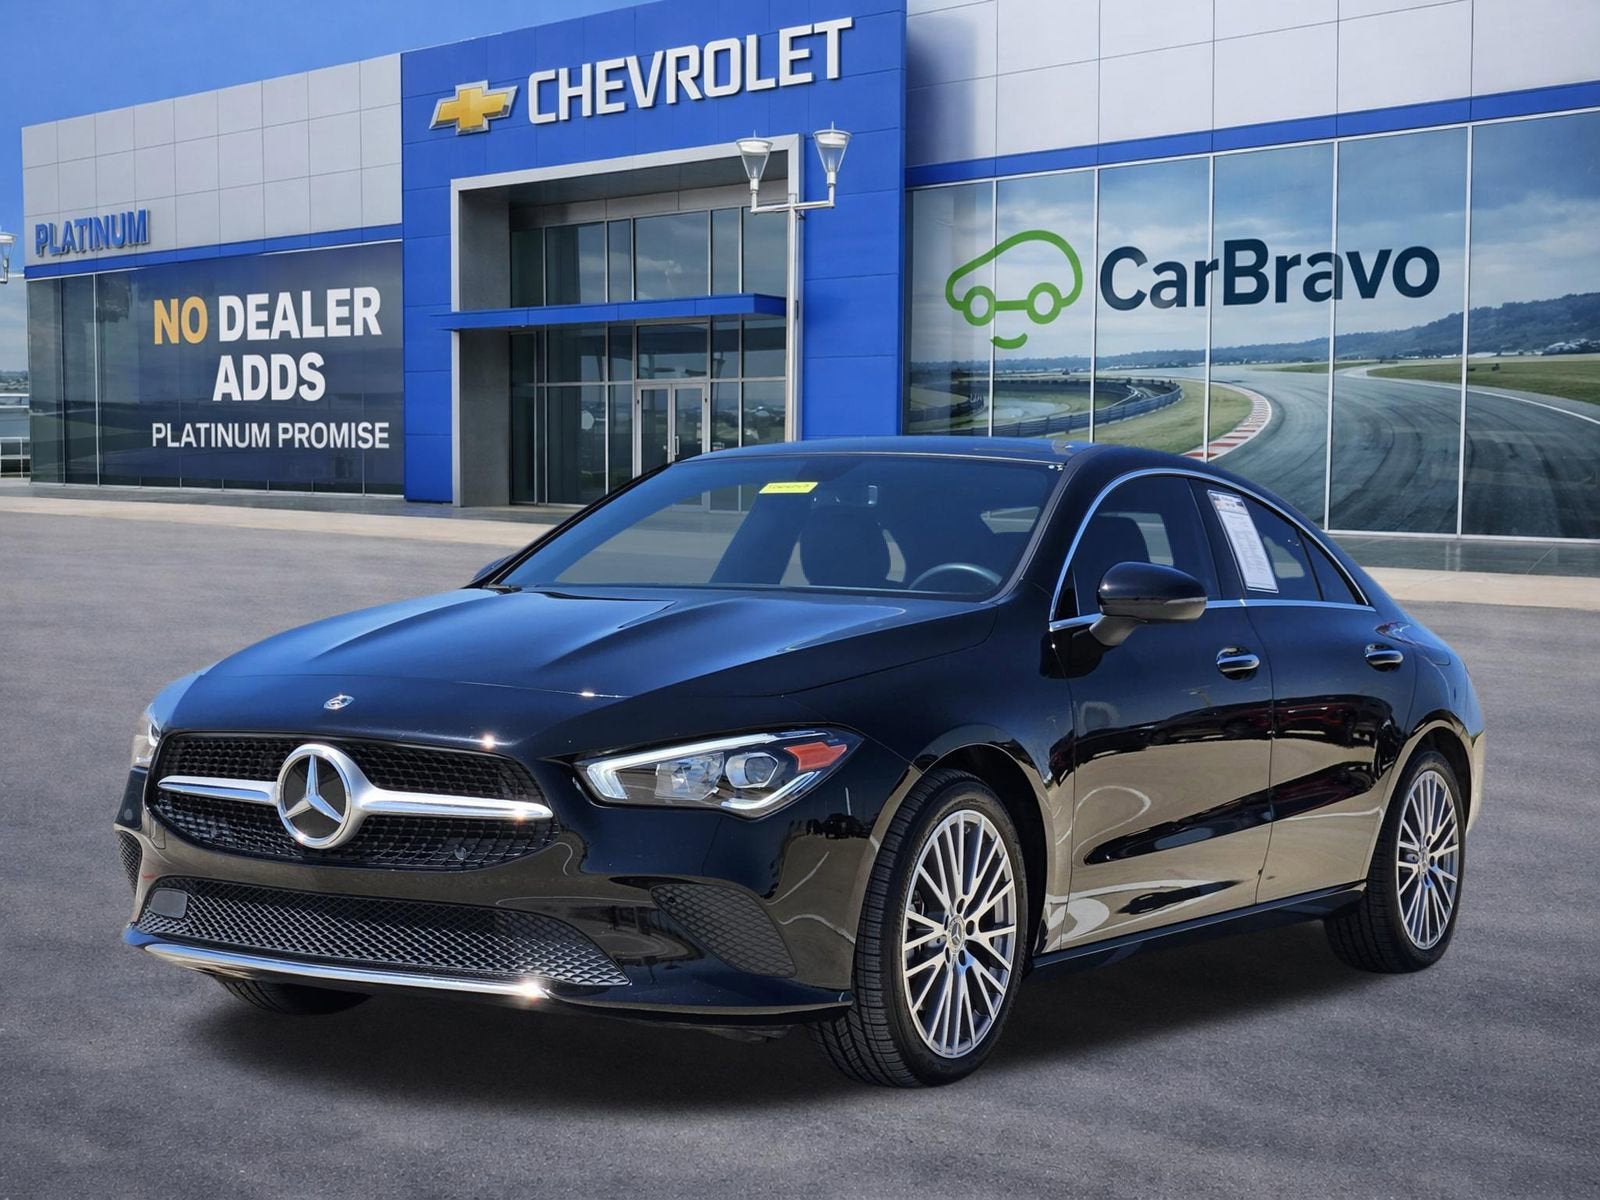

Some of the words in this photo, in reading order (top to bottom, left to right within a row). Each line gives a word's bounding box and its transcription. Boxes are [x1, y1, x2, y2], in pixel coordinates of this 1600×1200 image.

[528, 16, 854, 125] CHEVROLET
[35, 208, 150, 257] PLATINUM
[1100, 238, 1440, 311] CarBravo
[153, 296, 208, 345] NO
[218, 286, 382, 342] DEALER
[212, 352, 326, 401] ADDS
[152, 422, 270, 448] PLATINUM
[278, 421, 390, 449] PROMISE
